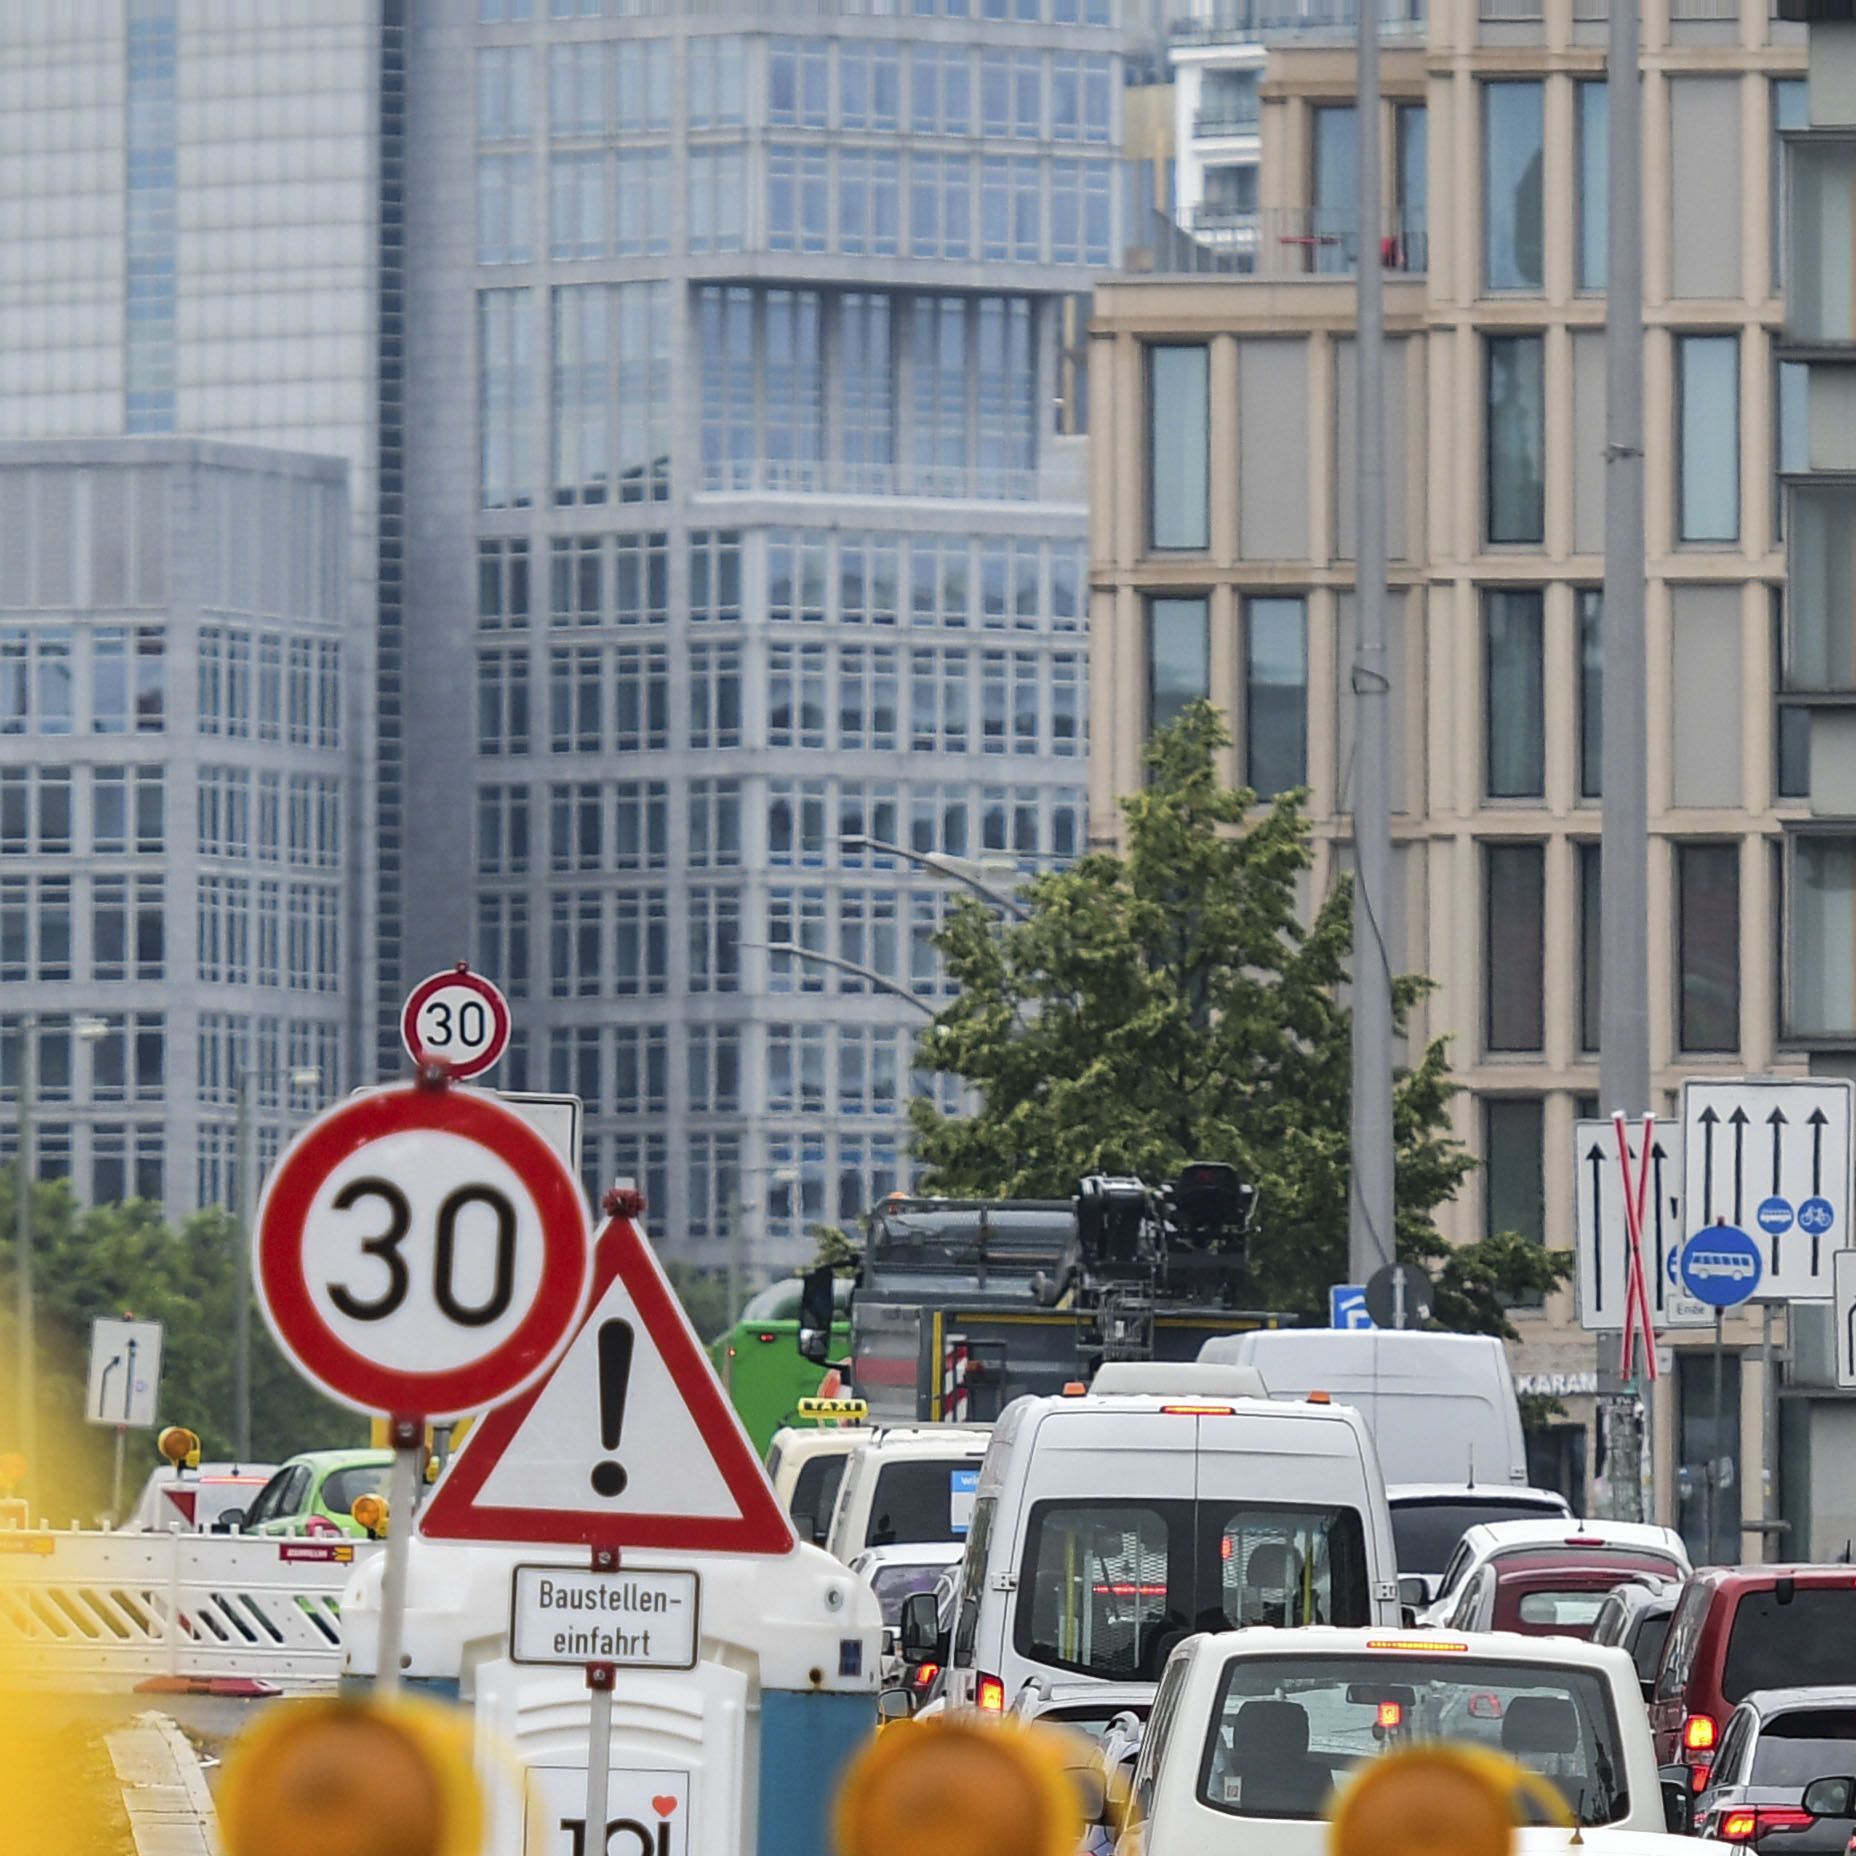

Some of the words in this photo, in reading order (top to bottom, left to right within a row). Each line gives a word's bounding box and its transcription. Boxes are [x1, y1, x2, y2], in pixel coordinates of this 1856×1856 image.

[425, 1001, 487, 1048] 30
[325, 1177, 518, 1327] 30
[810, 1401, 856, 1412] TAXI
[539, 1580, 683, 1615] Baustellen-
[553, 1627, 651, 1657] einfahrt
